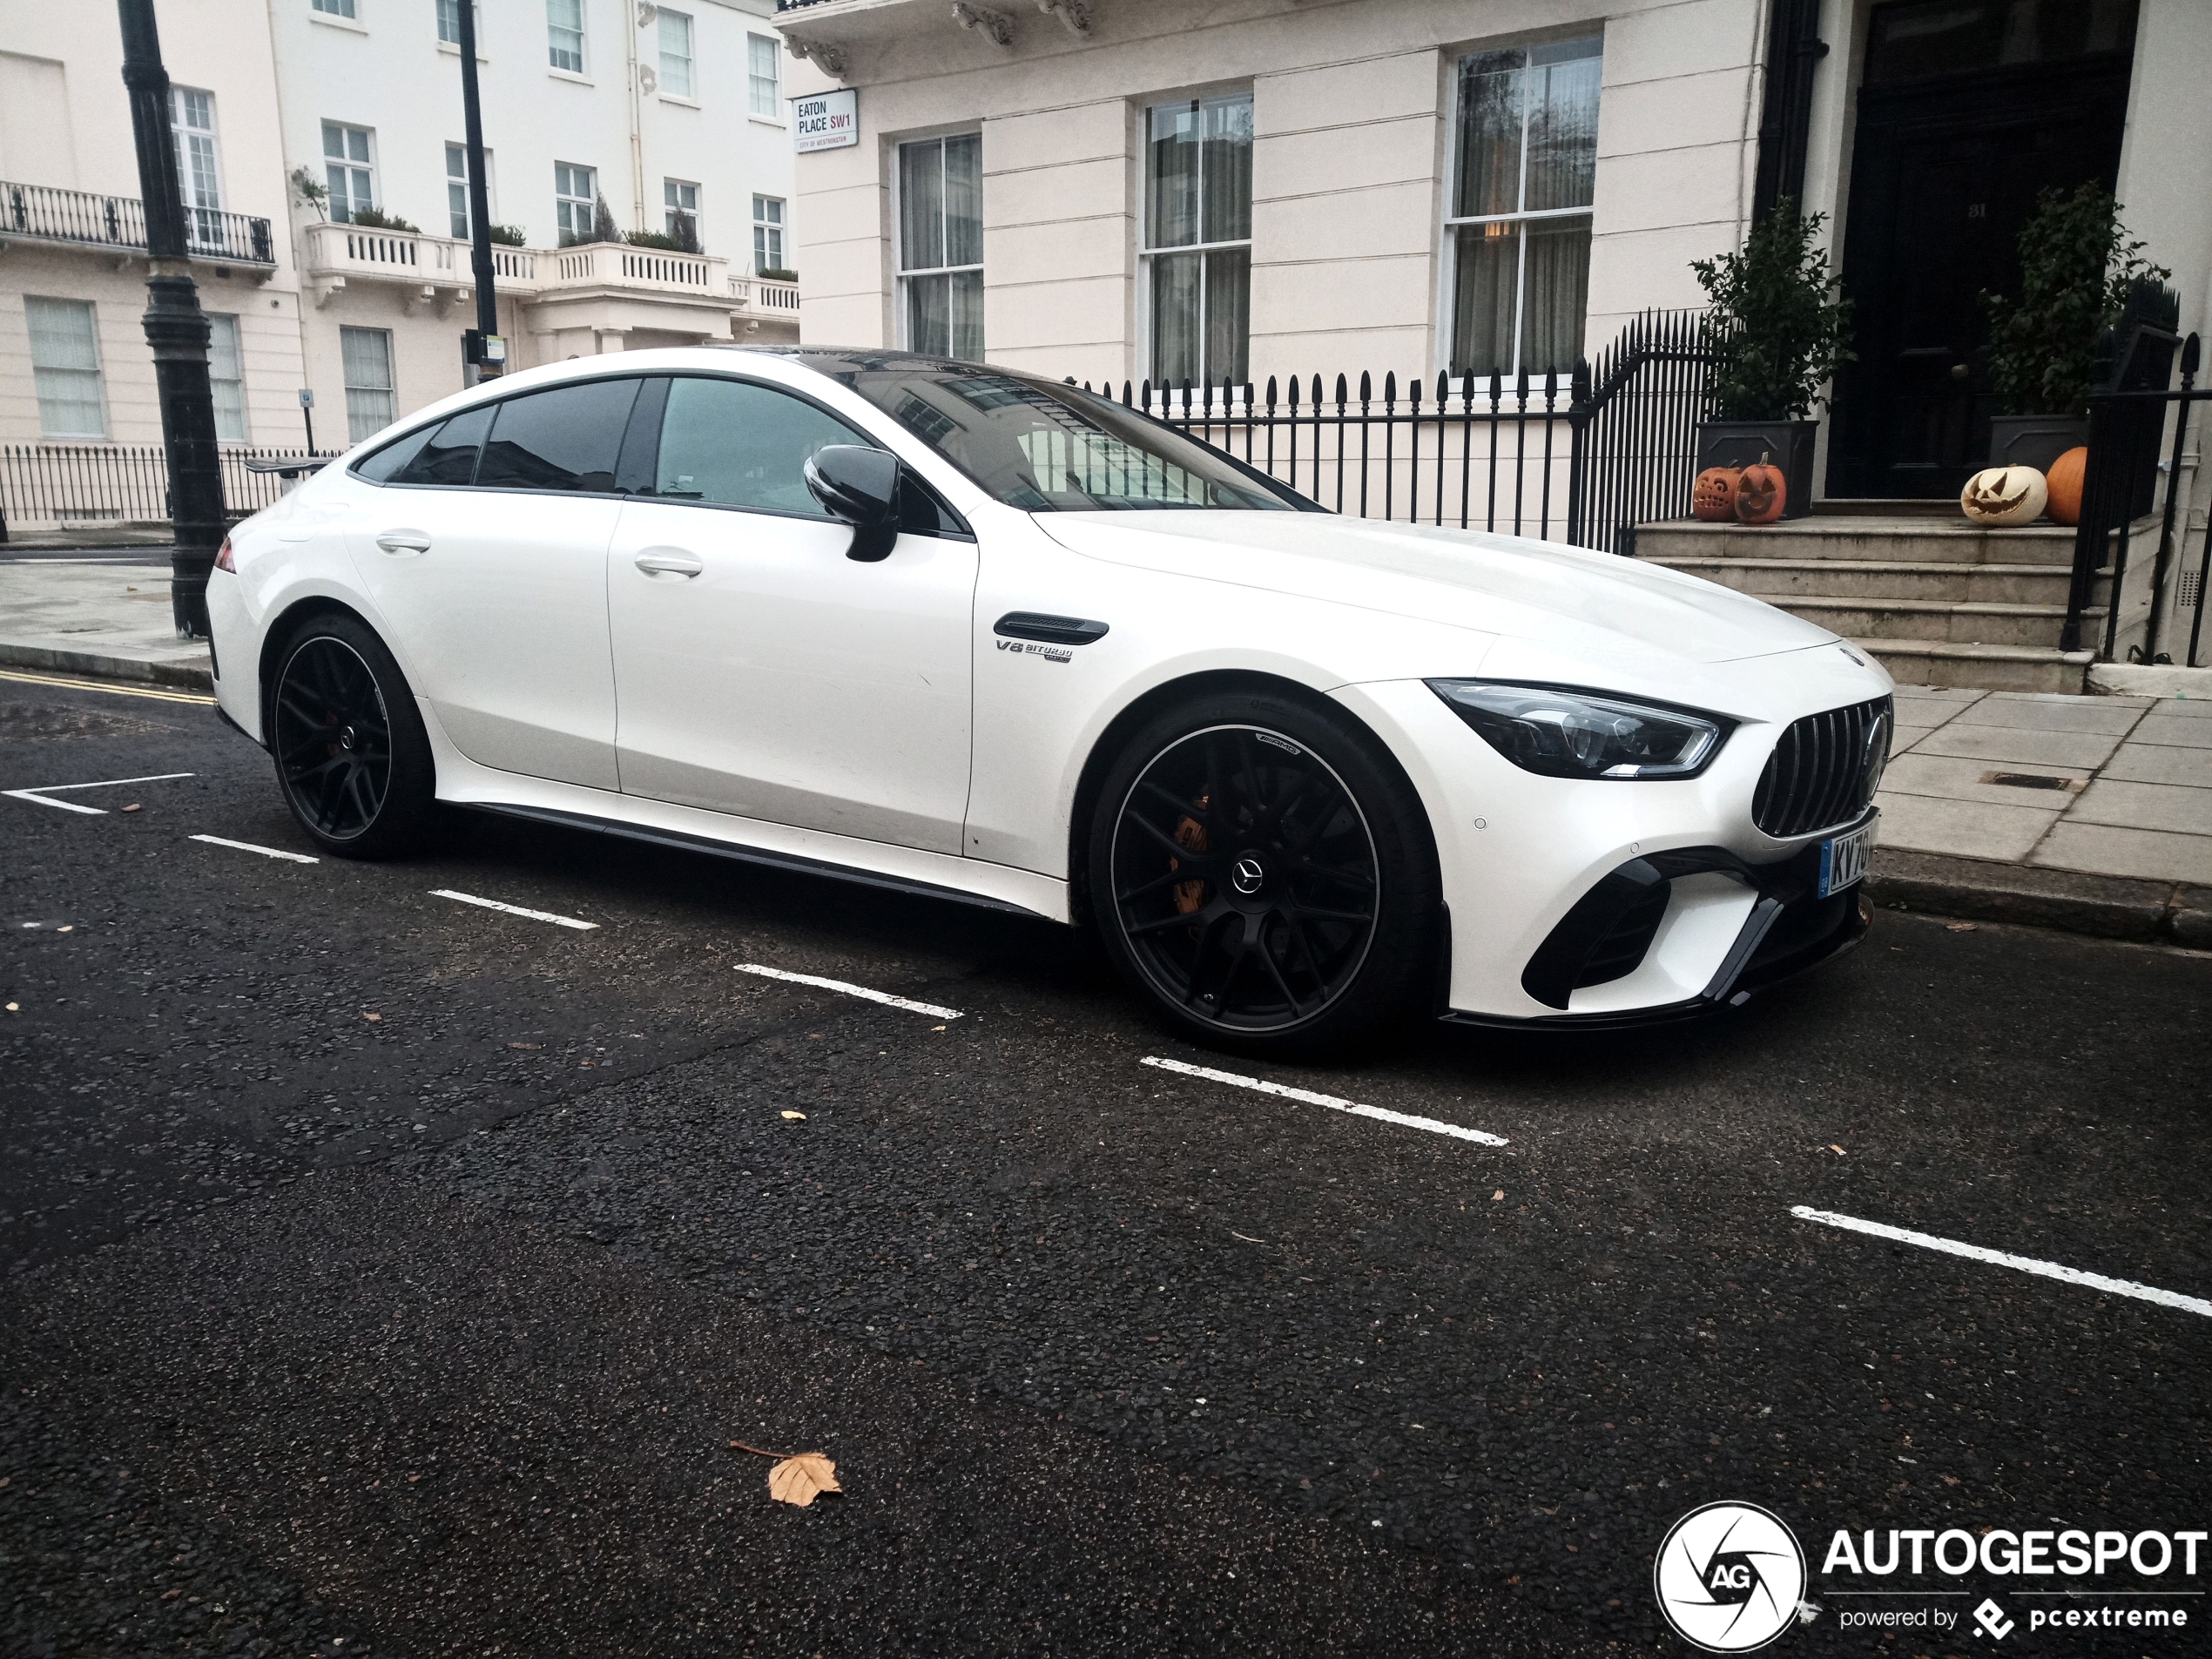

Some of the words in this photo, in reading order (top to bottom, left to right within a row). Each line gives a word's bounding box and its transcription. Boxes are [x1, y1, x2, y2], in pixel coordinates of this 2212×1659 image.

[799, 101, 826, 118] EATON
[799, 118, 826, 134] PLACE
[830, 113, 850, 129] SW1
[816, 136, 846, 146] WESTMINSTER
[996, 639, 1023, 653] V8
[1025, 644, 1073, 658] BITURBO
[1271, 739, 1297, 754] AMG
[1832, 830, 1869, 886] KV70
